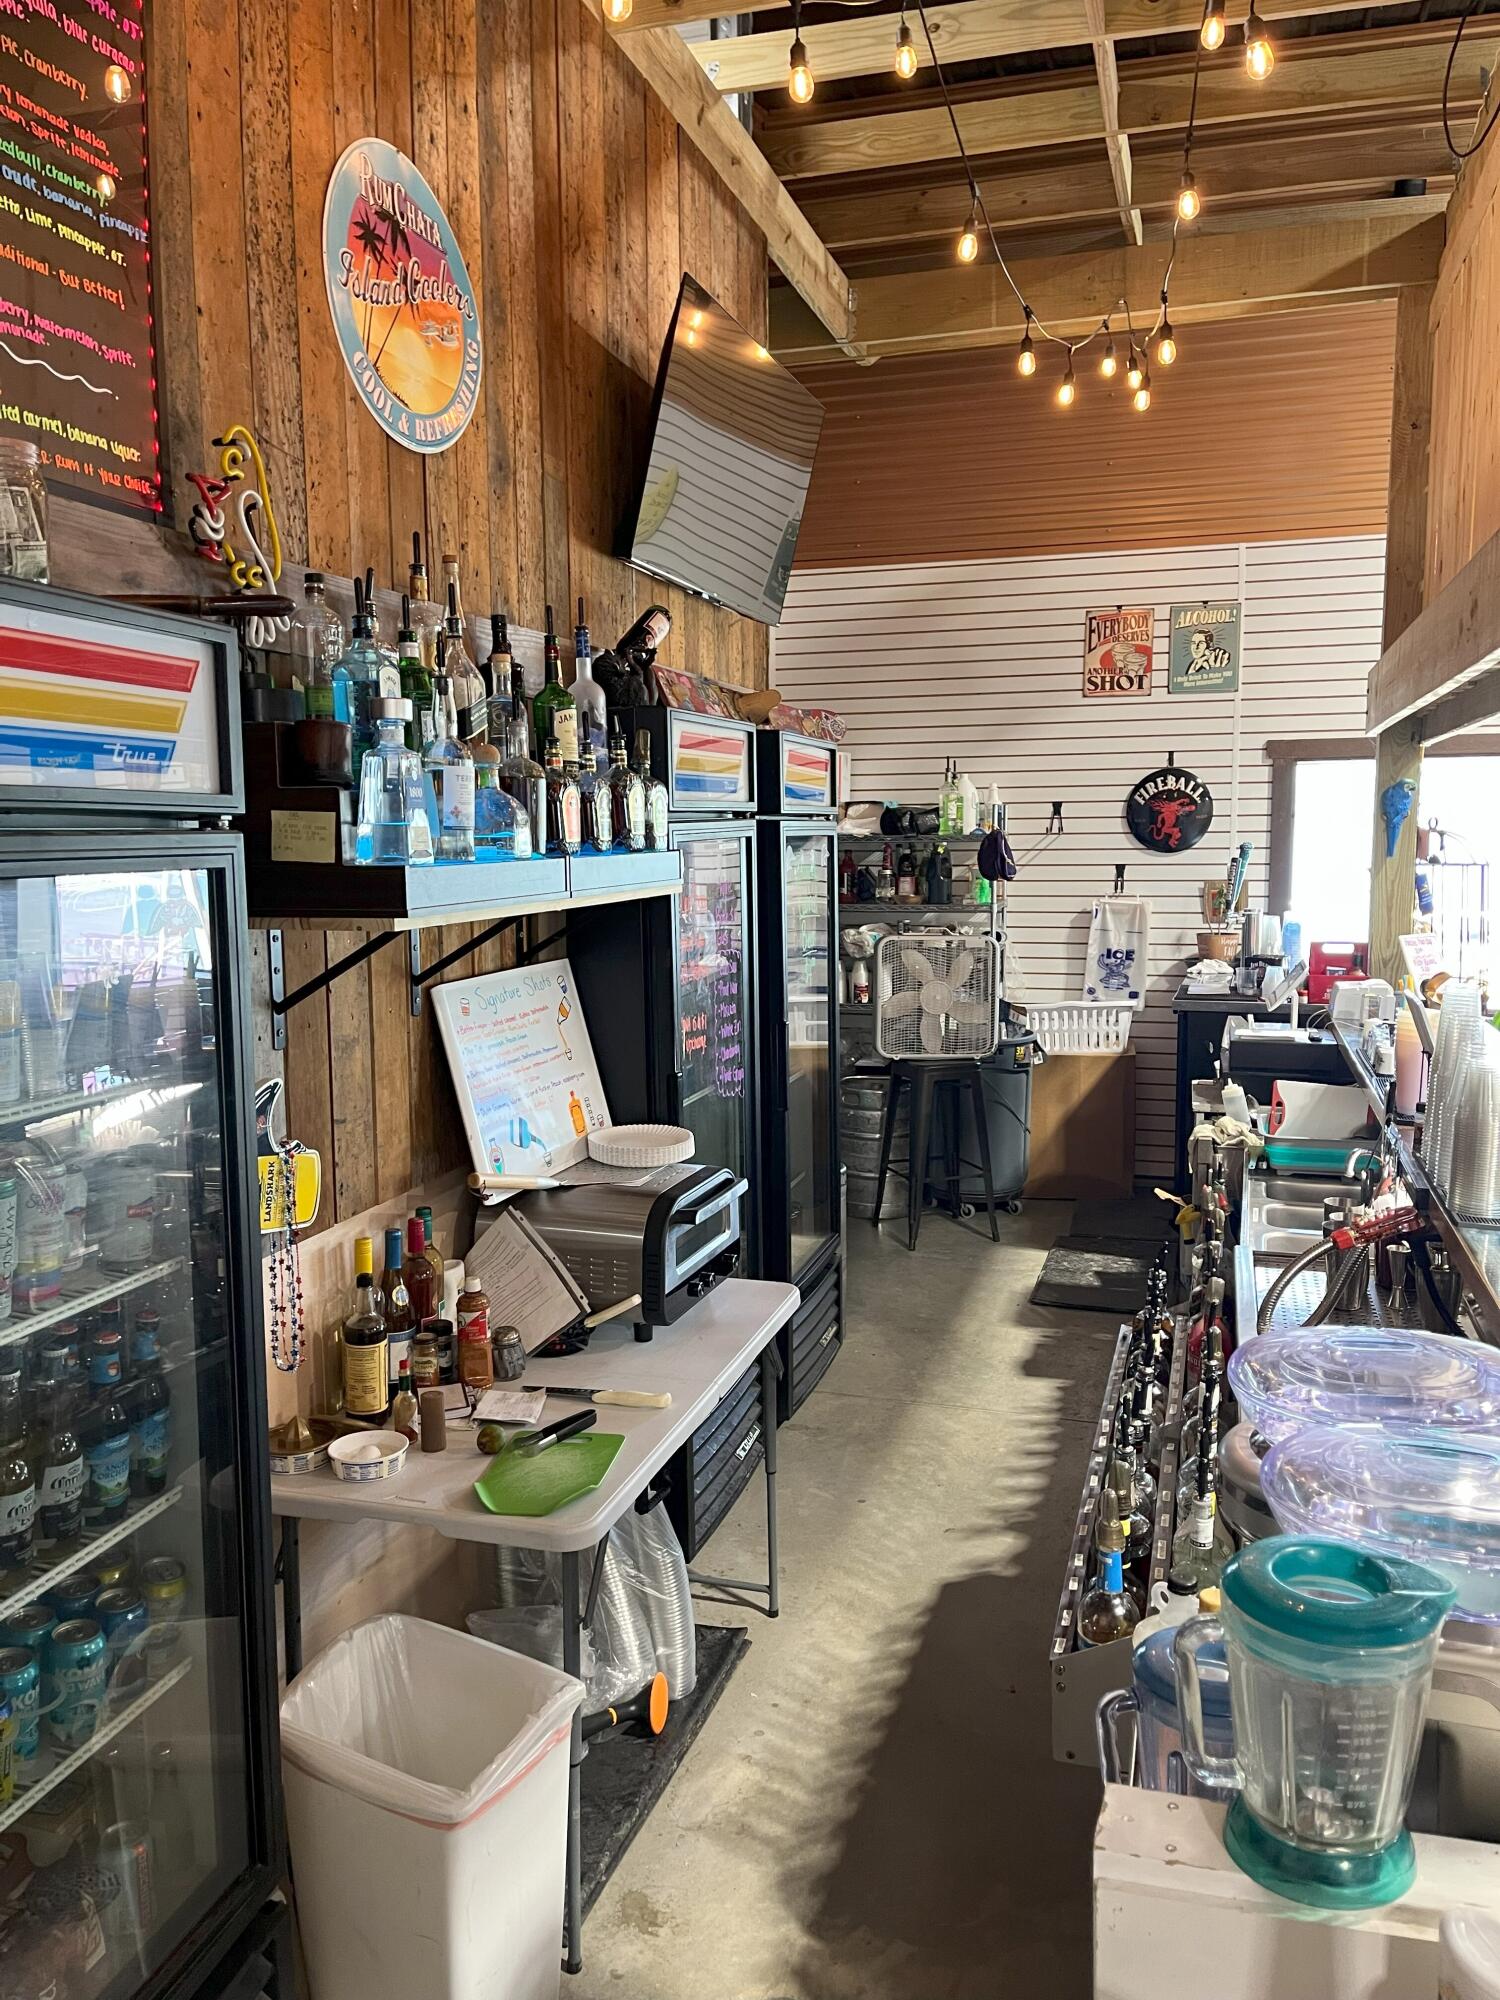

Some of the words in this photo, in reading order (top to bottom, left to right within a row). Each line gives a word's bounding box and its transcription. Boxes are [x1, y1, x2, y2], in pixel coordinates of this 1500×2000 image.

[62, 13, 88, 44] blue
[15, 91, 69, 132] lemonade
[84, 278, 125, 311] Better!
[338, 247, 406, 308] Island
[404, 257, 474, 320] Coolers
[352, 351, 394, 424] COOL
[398, 412, 411, 436] &
[415, 338, 481, 442] REFRESHING
[1088, 613, 1151, 653] EVERYBODY
[1175, 608, 1237, 629] ALCOHOL!
[1111, 629, 1150, 643] DESERVES
[1087, 667, 1123, 676] ANOTHER
[1087, 674, 1148, 692] SHOT
[1134, 775, 1205, 806] FIREBALL
[1105, 948, 1135, 962] ICE
[474, 986, 521, 1014] Signature
[523, 976, 552, 997] Shots
[264, 1161, 275, 1222] LANDSHARK
